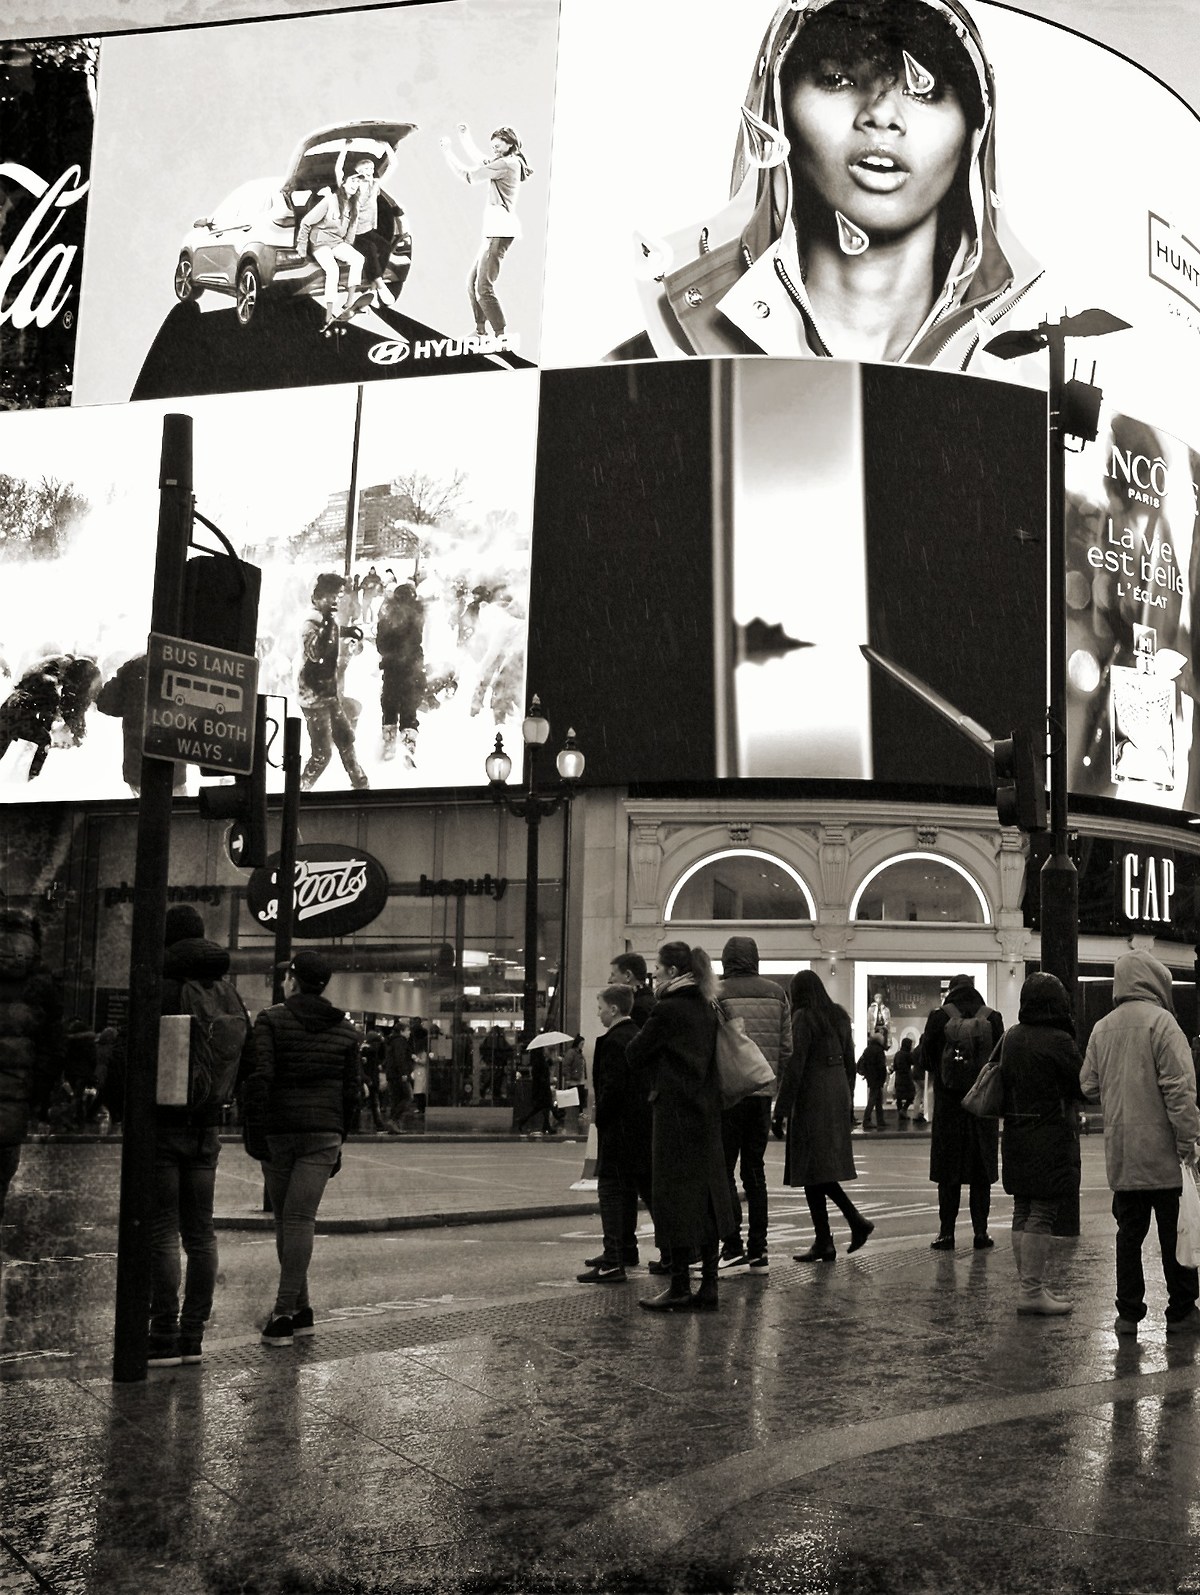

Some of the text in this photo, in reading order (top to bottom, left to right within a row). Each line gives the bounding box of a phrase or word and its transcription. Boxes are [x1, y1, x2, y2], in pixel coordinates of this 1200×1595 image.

[1128, 488, 1160, 508] PARIS
[1108, 518, 1135, 550] La
[1087, 546, 1183, 596] est belle
[162, 645, 245, 679] BUS LANE
[153, 709, 247, 742] LOOK BOTH
[178, 738, 222, 761] WAYS
[420, 873, 508, 900] beauty
[1123, 853, 1175, 922] GAP
